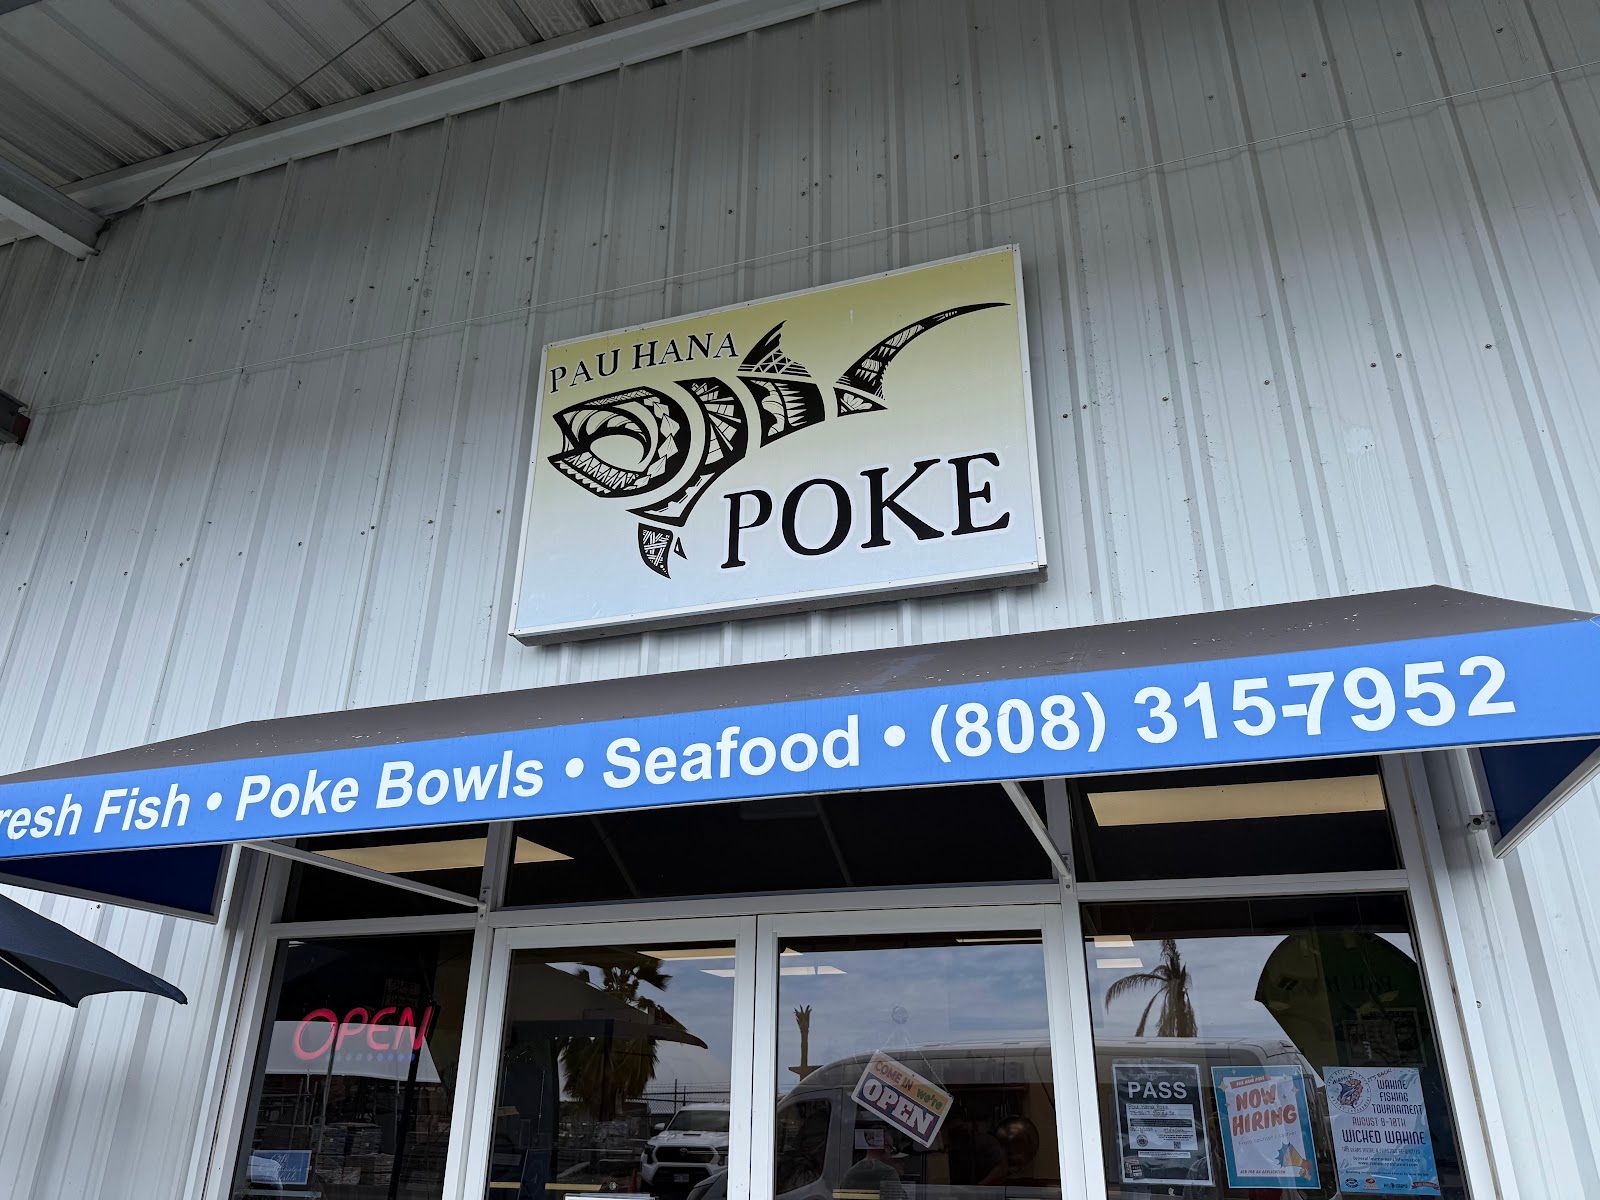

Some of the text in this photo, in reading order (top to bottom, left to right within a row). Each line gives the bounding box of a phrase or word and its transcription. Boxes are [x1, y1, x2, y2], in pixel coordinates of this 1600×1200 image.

[549, 332, 740, 395] PAU HANA
[720, 452, 1011, 569] POKE
[93, 783, 191, 833] Fish
[235, 769, 359, 821] Poke
[376, 750, 544, 809] Bowls
[603, 714, 860, 789] Seafood
[930, 691, 1106, 763] (808)
[1134, 655, 1516, 744] 315-7952
[293, 1005, 433, 1060] OPEN
[874, 1061, 903, 1083] COME
[902, 1076, 914, 1091] IN
[1127, 1081, 1187, 1099] PASS
[1376, 1079, 1408, 1090] WAHINE
[862, 1078, 935, 1135] OPEN
[1235, 1083, 1277, 1111] NOW
[1372, 1103, 1423, 1115] TOURNAMENT
[1379, 1091, 1409, 1102] FISHING
[1232, 1103, 1298, 1136] HIRING
[1352, 1117, 1379, 1127] AUGUST
[1341, 1129, 1427, 1145] WICKED WAHINE
